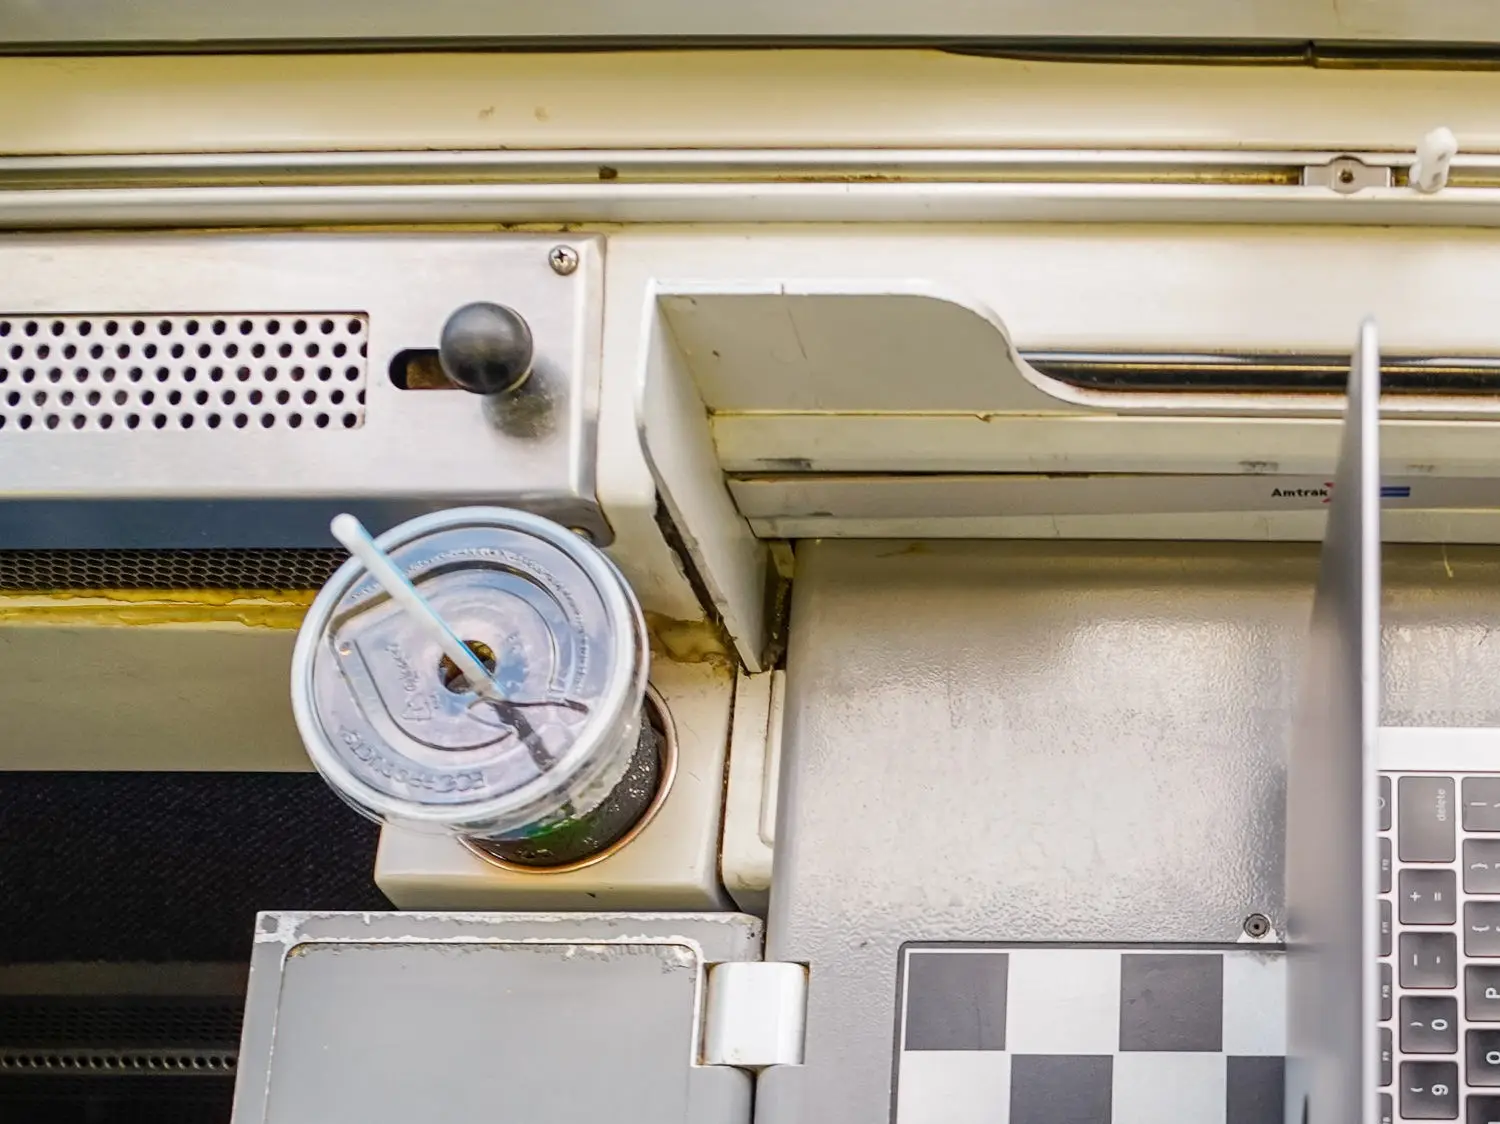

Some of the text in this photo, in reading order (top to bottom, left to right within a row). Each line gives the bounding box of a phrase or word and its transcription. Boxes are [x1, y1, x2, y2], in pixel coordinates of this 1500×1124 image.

[1270, 487, 1329, 498] Amtrak
[1435, 789, 1446, 821] delete
[1431, 1019, 1448, 1030] 0
[1432, 1084, 1448, 1096] 9
